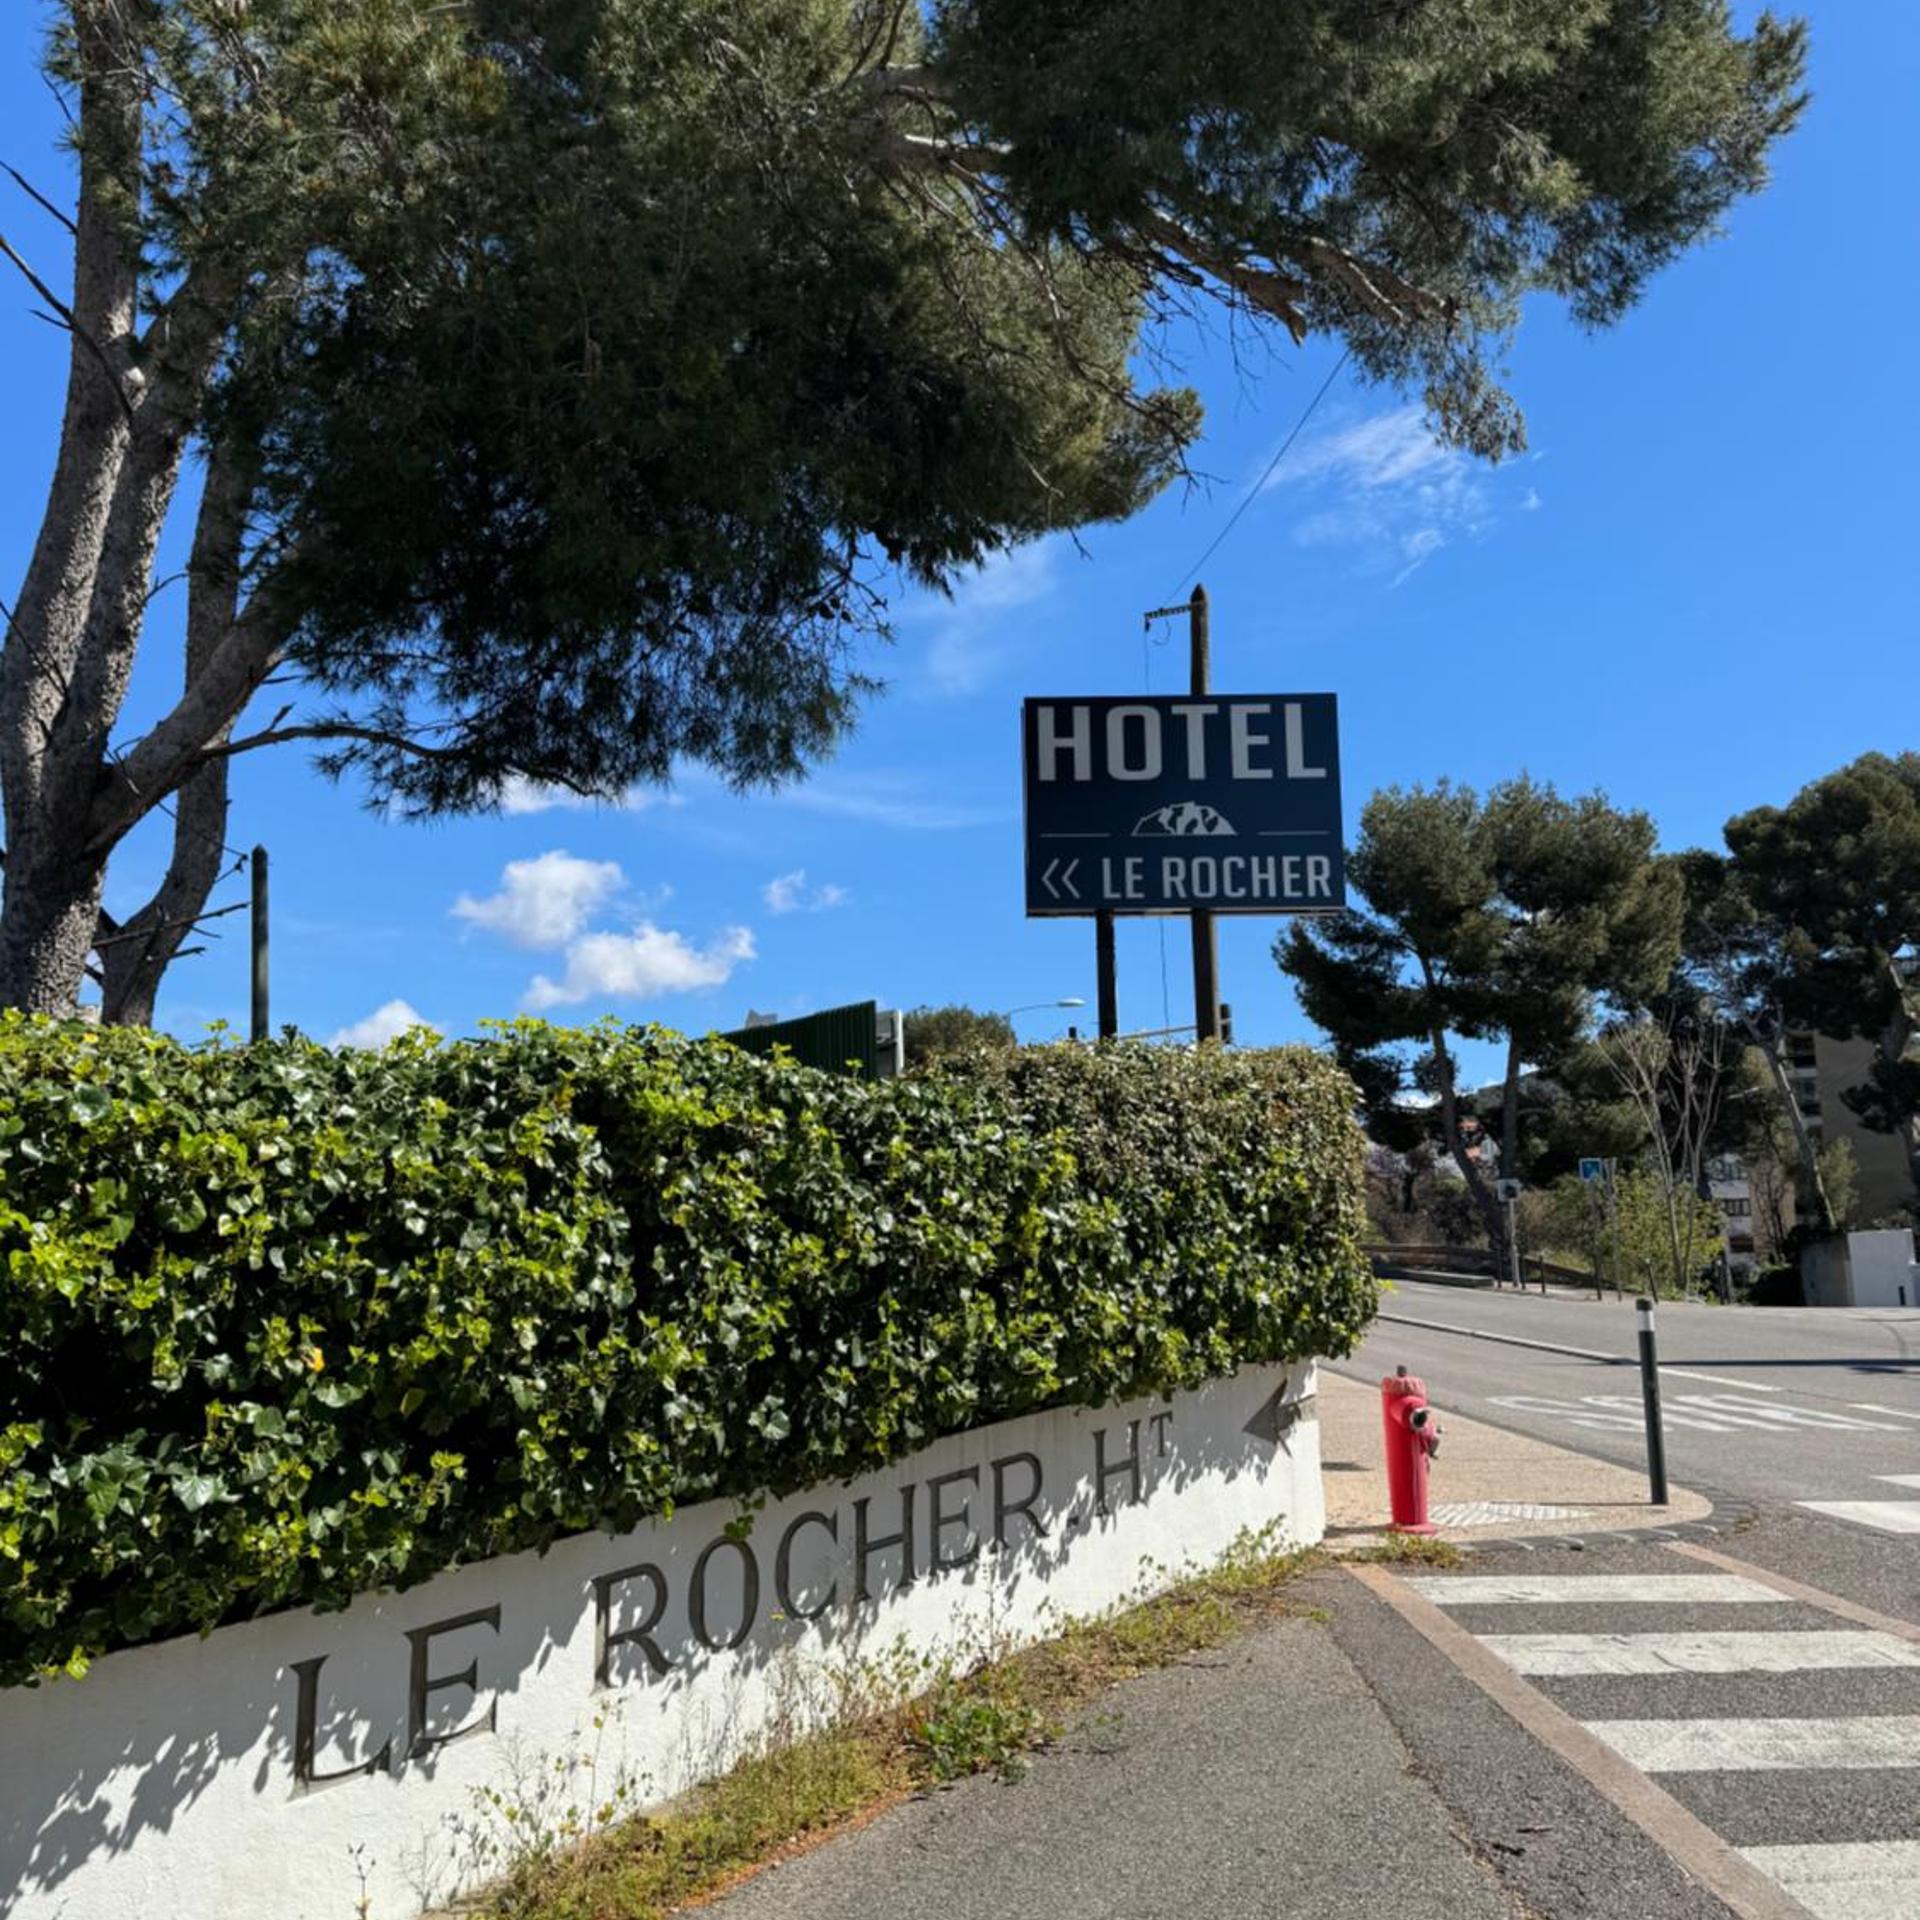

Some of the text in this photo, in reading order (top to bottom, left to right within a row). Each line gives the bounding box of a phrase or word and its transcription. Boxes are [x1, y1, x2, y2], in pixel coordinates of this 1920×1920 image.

[1037, 703, 1328, 782] HOTEL
[1102, 855, 1332, 899] LE ROCHER
[288, 1602, 501, 1802] LE
